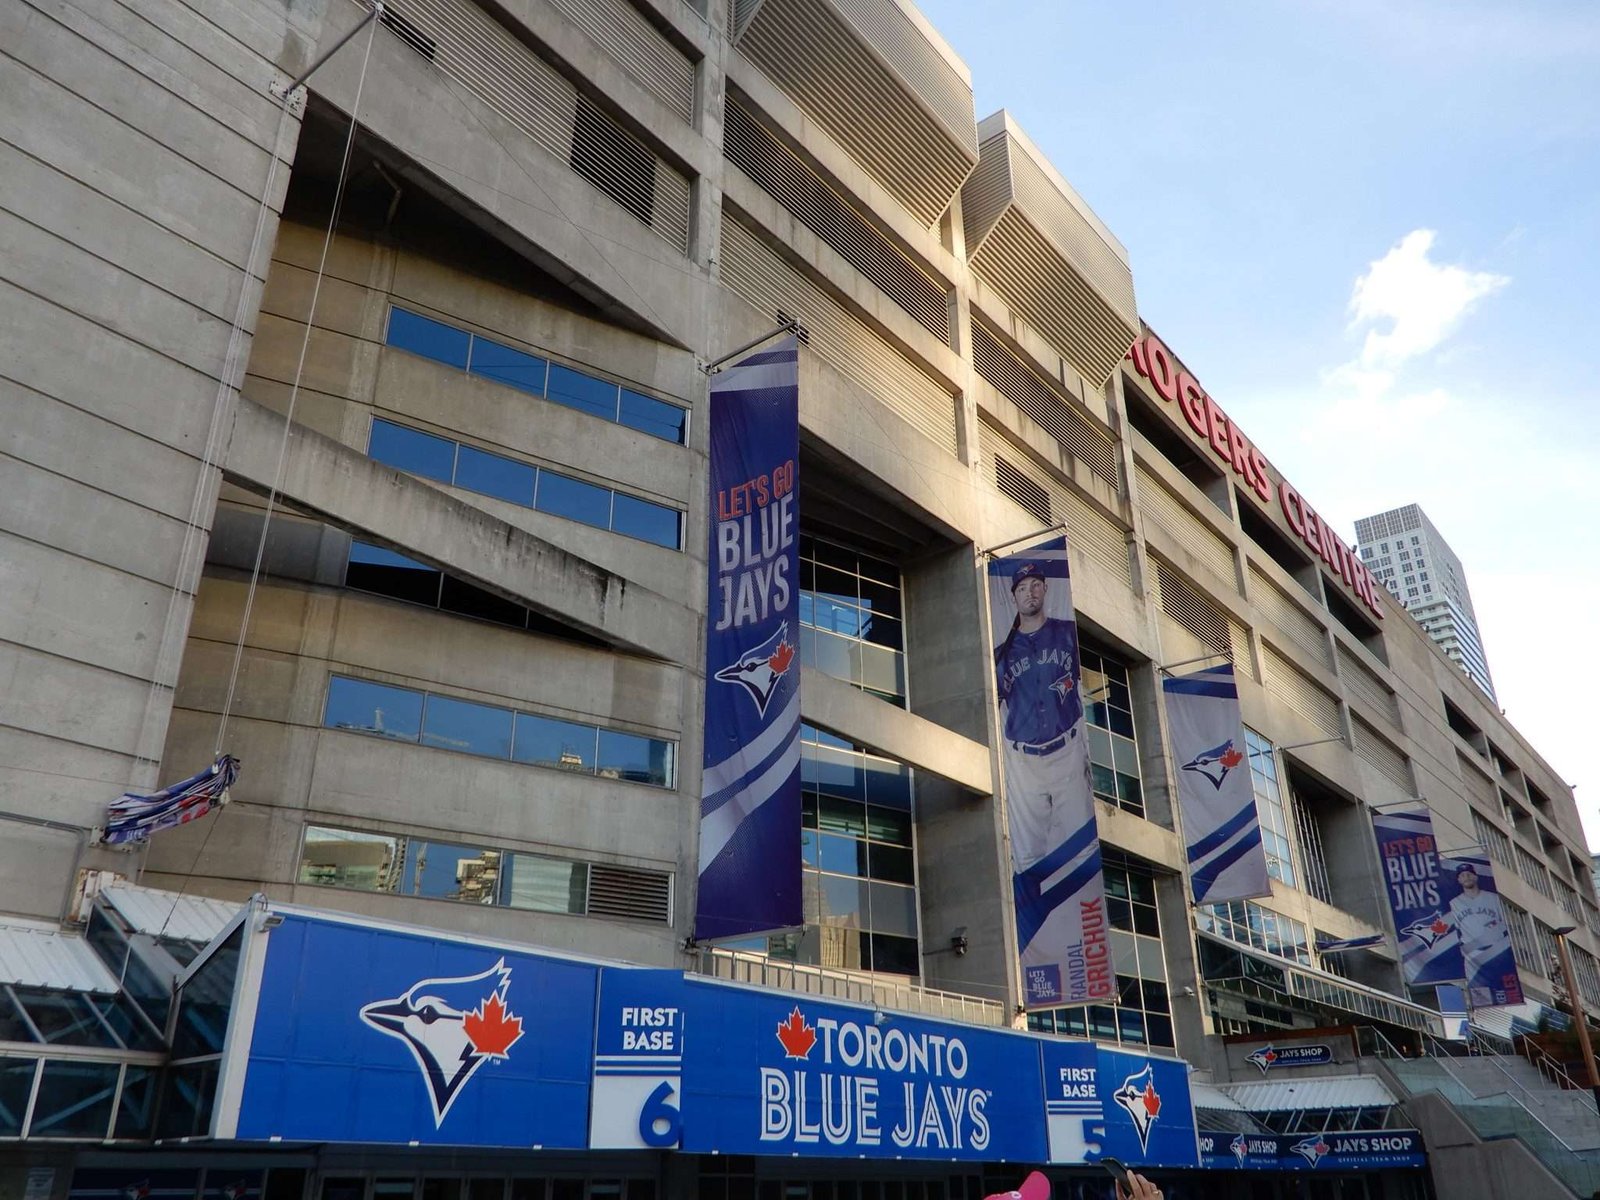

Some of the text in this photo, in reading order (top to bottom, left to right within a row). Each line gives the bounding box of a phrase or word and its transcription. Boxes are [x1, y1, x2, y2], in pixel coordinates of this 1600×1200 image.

[719, 459, 794, 521] LET'S GO
[718, 492, 794, 572] BLUE
[1278, 480, 1384, 619] CENTRE
[715, 553, 790, 631] JAYS
[1036, 648, 1073, 671] JAYS
[1417, 835, 1433, 854] GO
[1386, 852, 1440, 884] BLUE
[1391, 879, 1441, 911] JAYS
[1080, 897, 1112, 997] GRICHUK
[1067, 939, 1087, 1000] RANDAL
[622, 1007, 678, 1027] FIRST
[622, 1030, 674, 1050] BASE
[817, 1018, 968, 1080] TORONTO
[1280, 1047, 1323, 1058] JAYS SHOP
[1060, 1068, 1097, 1081] FIRST
[1062, 1084, 1097, 1097] BASE
[639, 1080, 680, 1148] 6
[760, 1067, 990, 1151] BLUE JAYS
[1200, 1137, 1214, 1152] HOP
[1261, 1140, 1277, 1154] SHOP
[1334, 1137, 1412, 1152] JAYS SHOP
